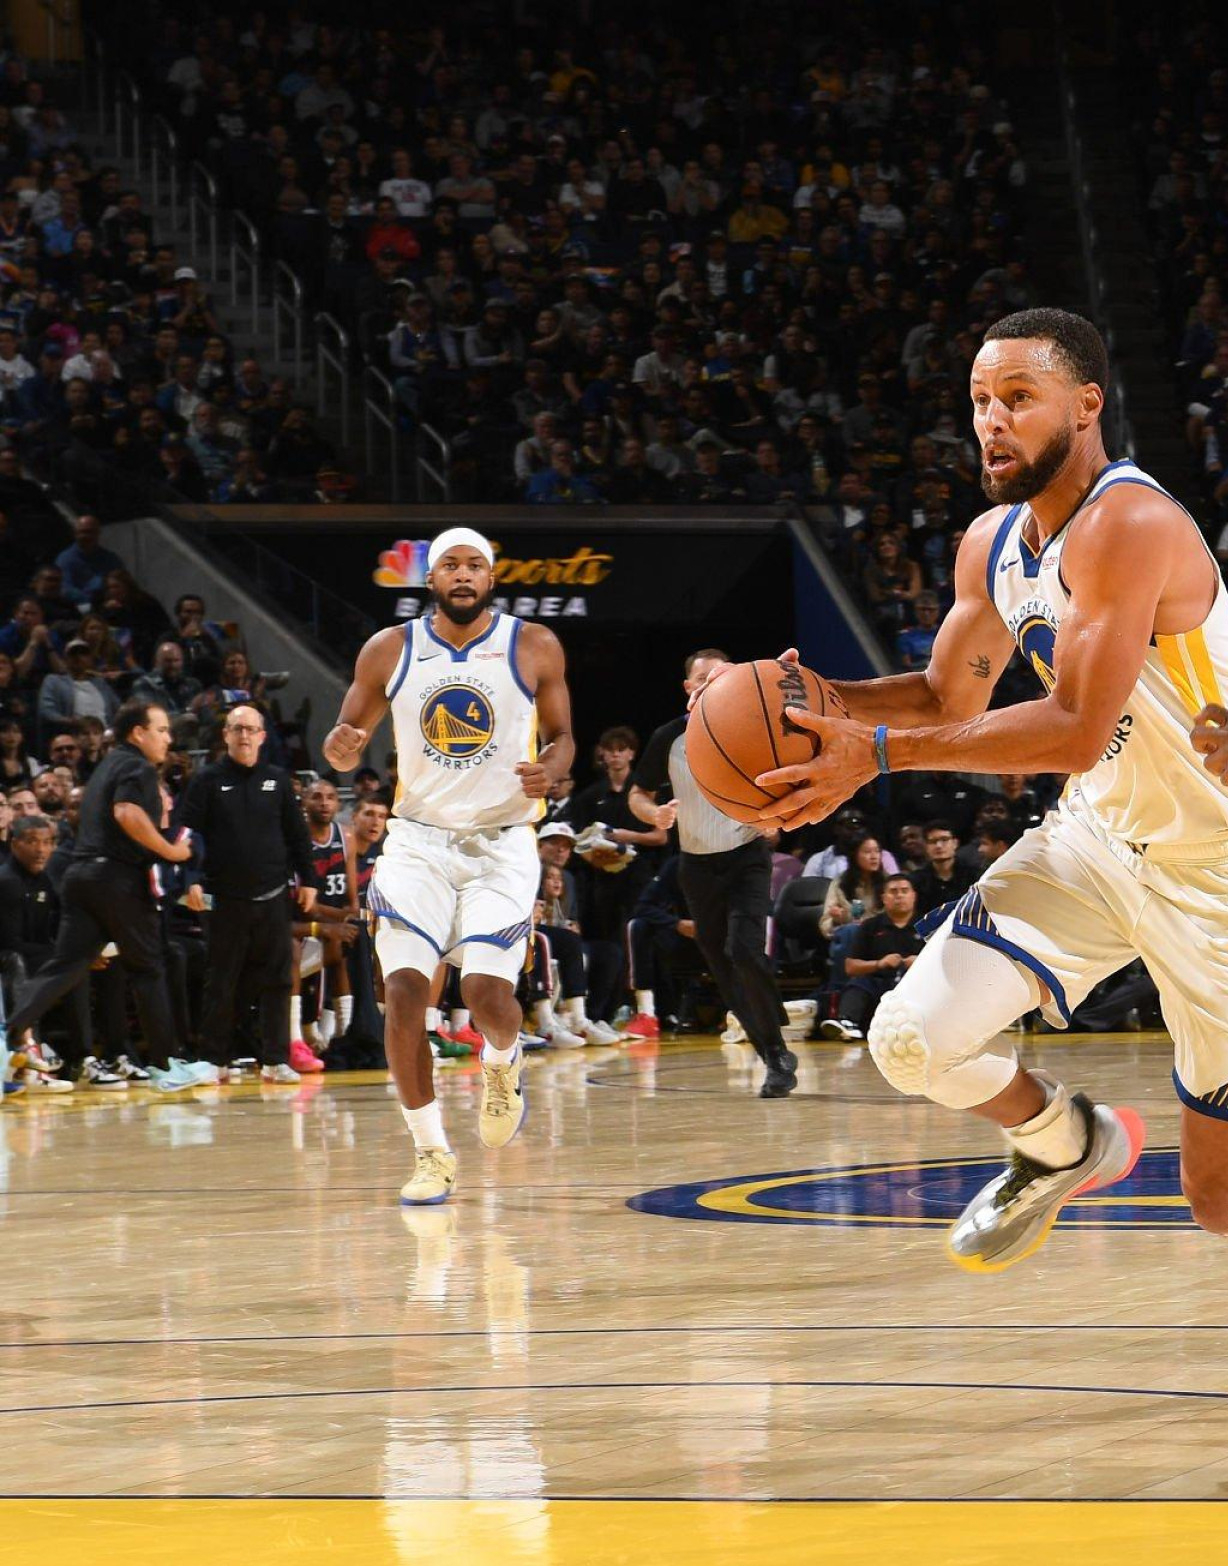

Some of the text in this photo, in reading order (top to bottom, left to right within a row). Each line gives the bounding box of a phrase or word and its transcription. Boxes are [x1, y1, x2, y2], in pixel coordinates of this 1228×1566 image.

[489, 540, 613, 586] ports
[394, 597, 436, 618] BA
[1008, 600, 1041, 634] OLDEN
[419, 674, 496, 701] GOLDEN STATE
[466, 701, 482, 722] 4
[422, 742, 499, 770] WARRIORS
[325, 873, 346, 896] 33
